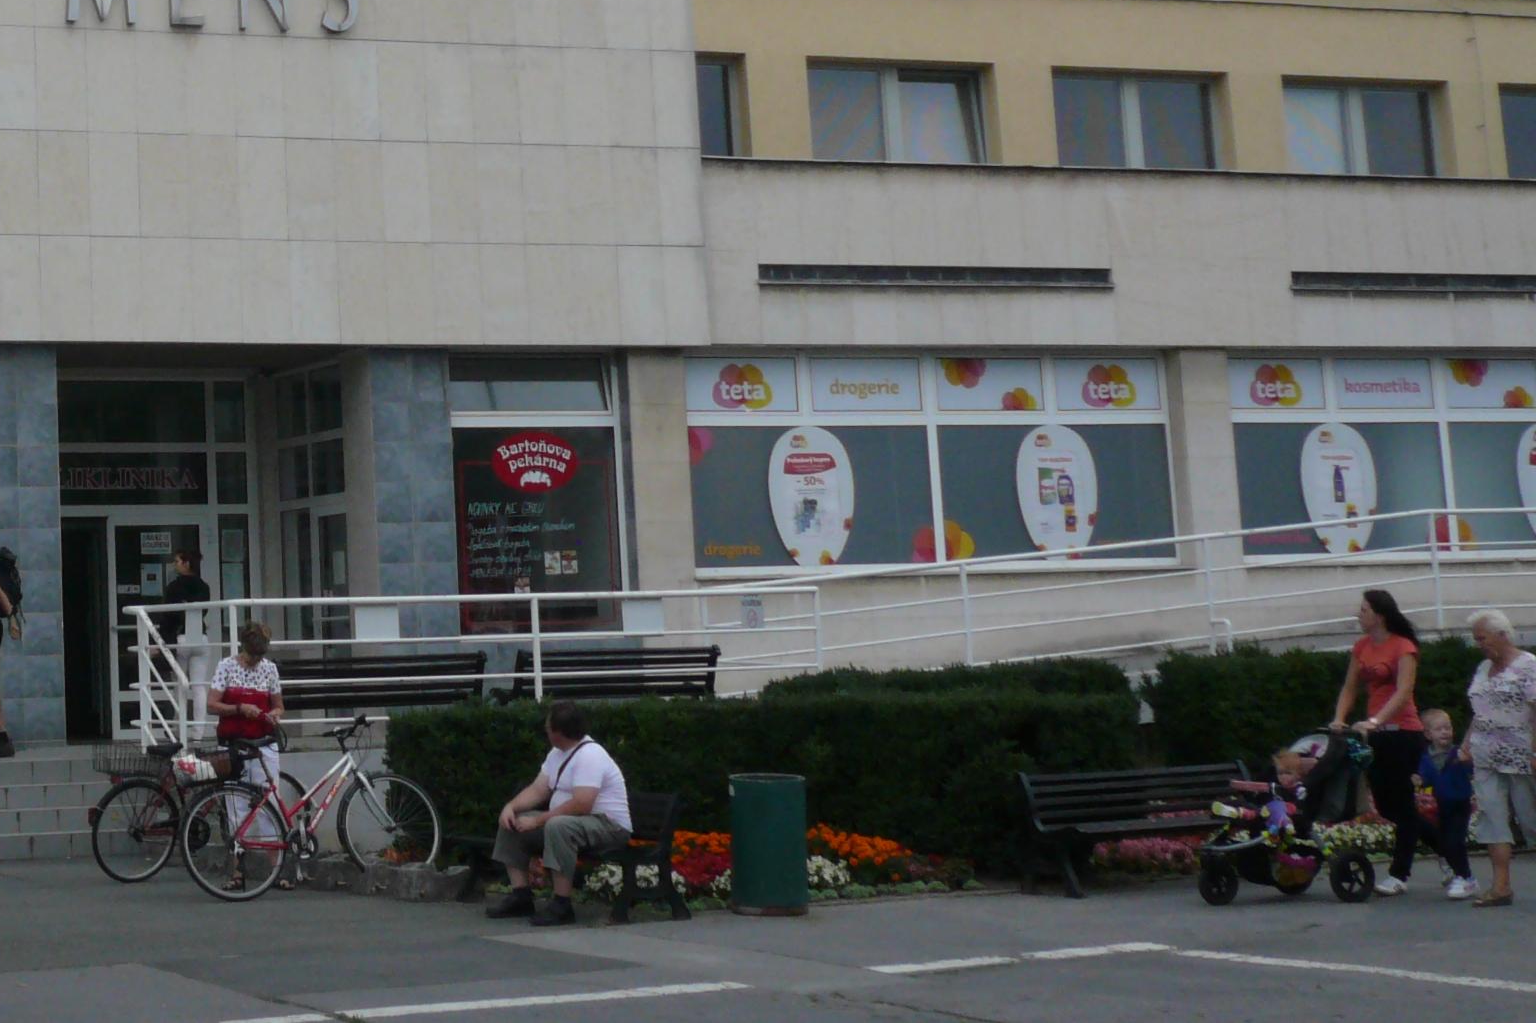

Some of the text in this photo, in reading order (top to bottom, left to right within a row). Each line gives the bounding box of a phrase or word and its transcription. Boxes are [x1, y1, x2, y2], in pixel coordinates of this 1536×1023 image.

[719, 381, 766, 401] teta
[829, 378, 900, 400] drogerie
[1087, 381, 1131, 400] teta
[1255, 380, 1297, 398] teta
[1344, 377, 1421, 394] kosmetika
[496, 439, 572, 461] Bartoňova
[507, 454, 567, 473] pekárna
[703, 540, 762, 560] drogerie
